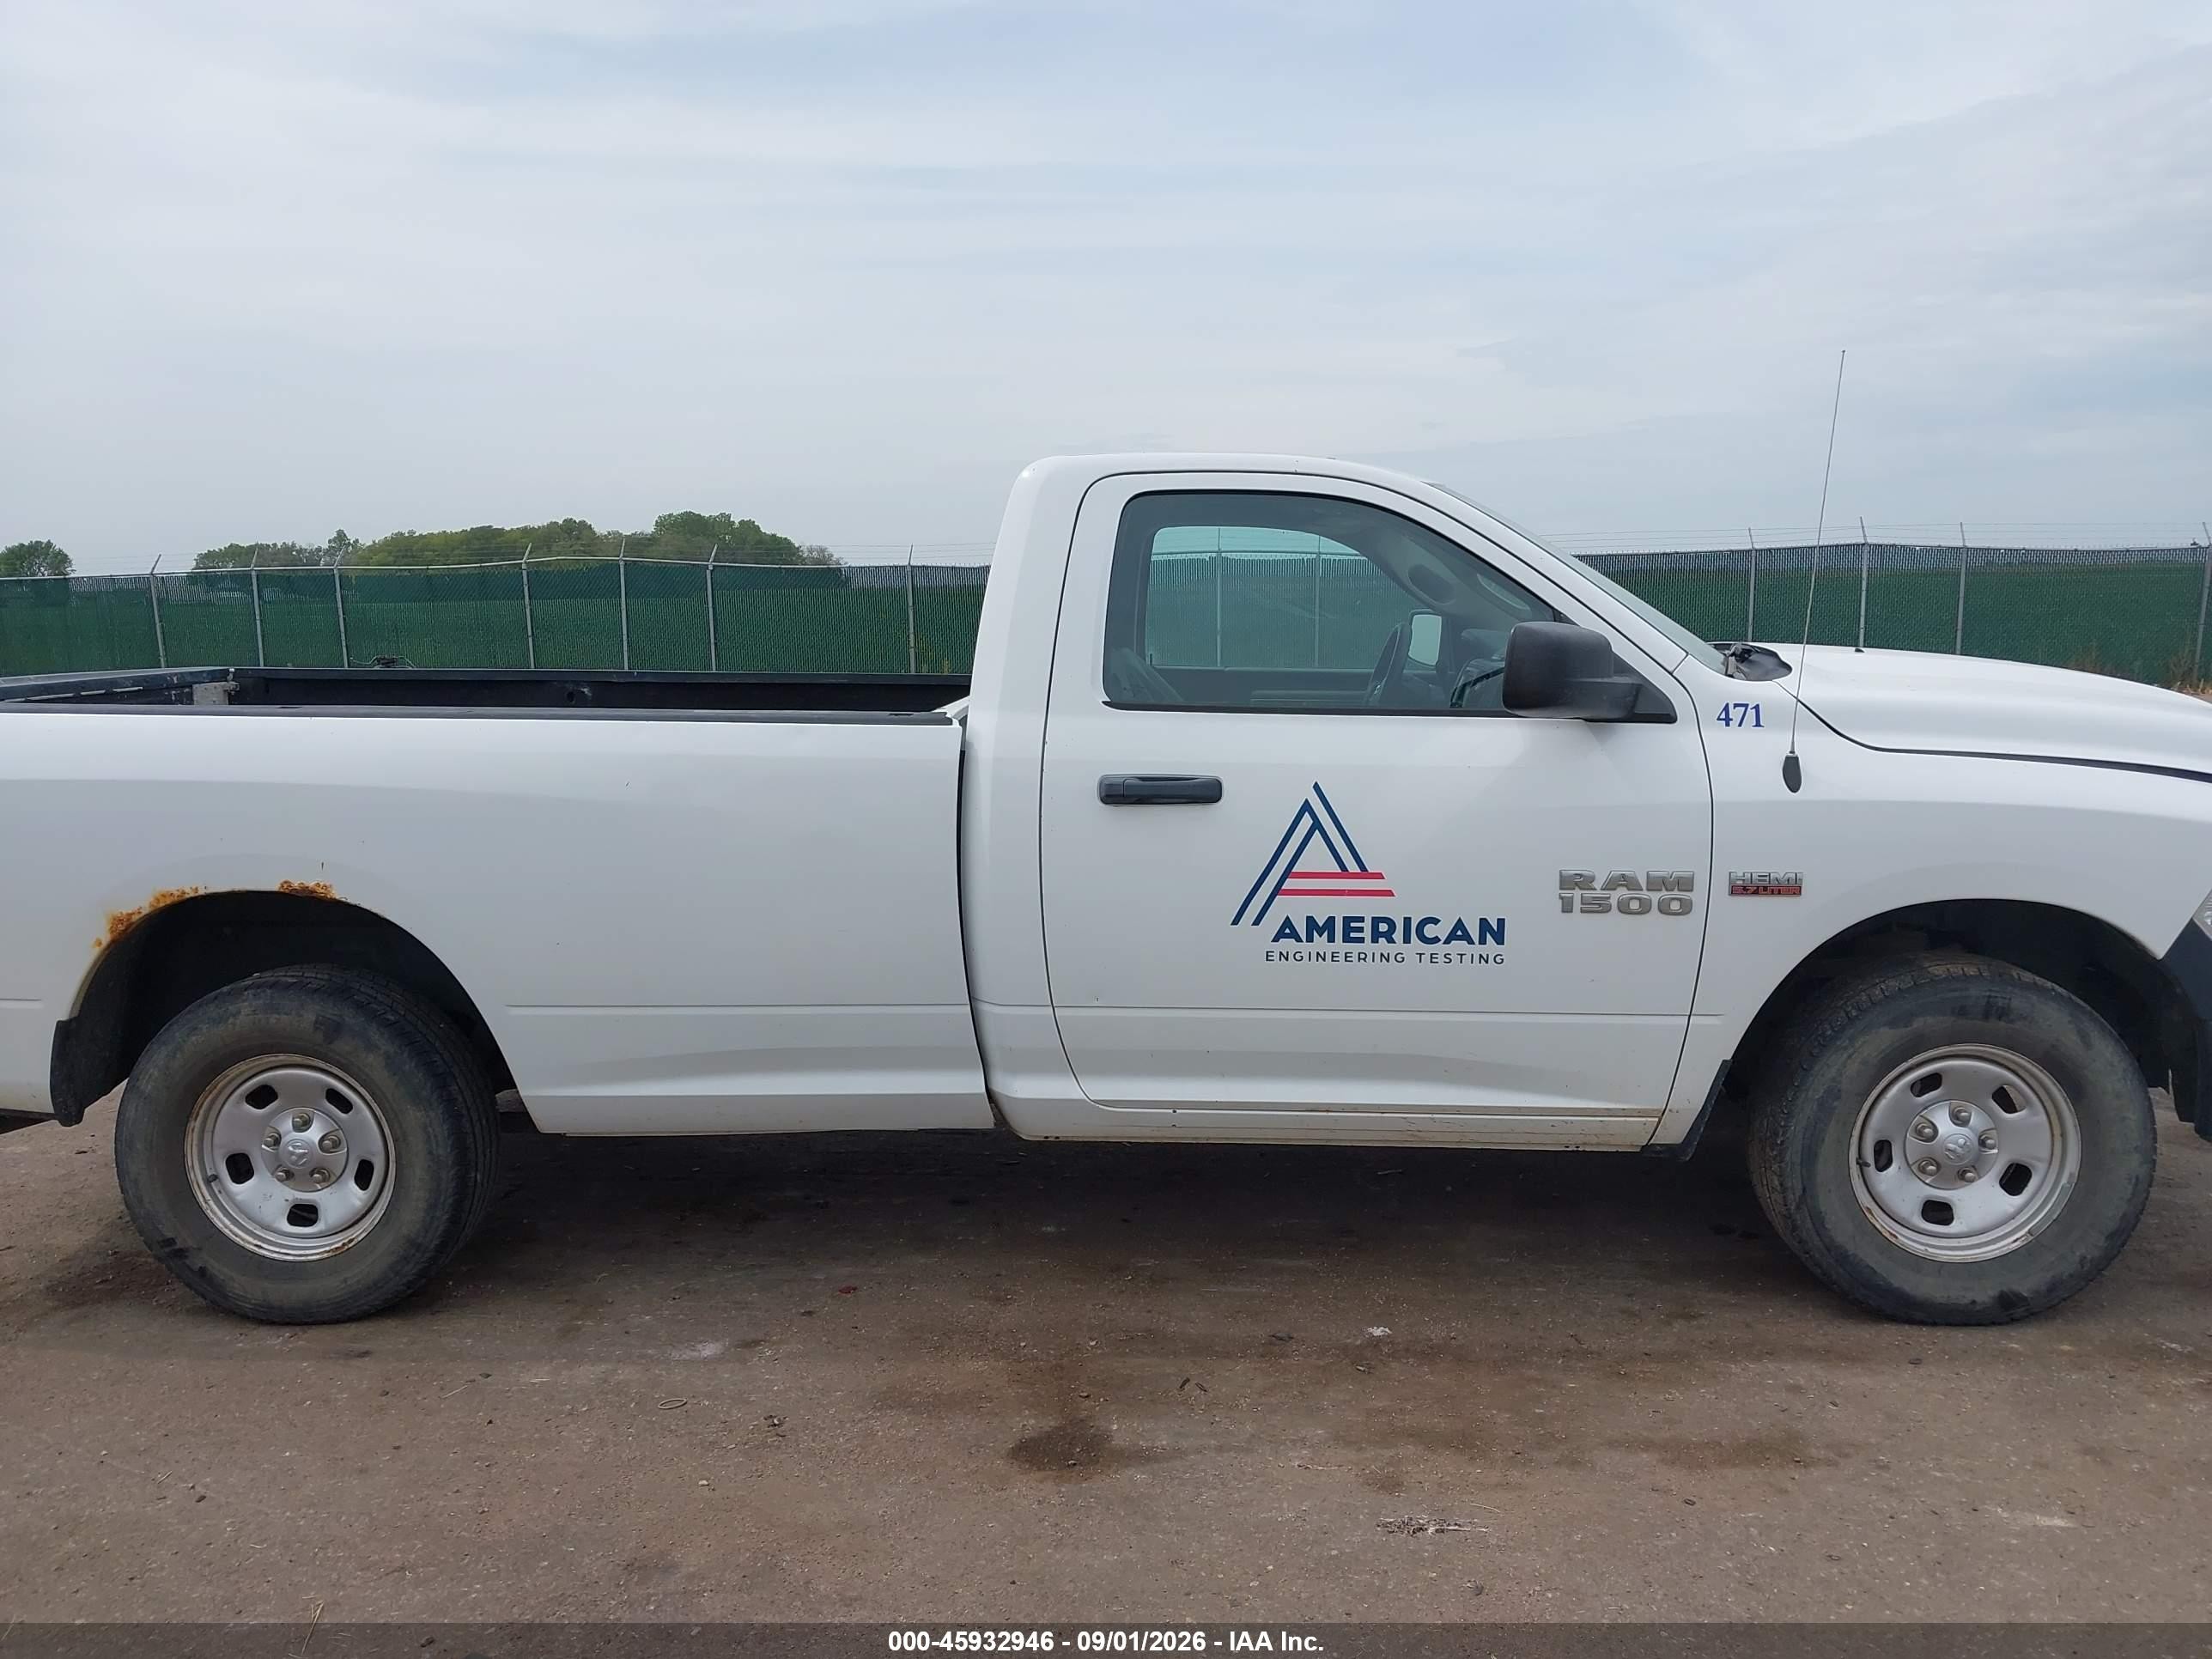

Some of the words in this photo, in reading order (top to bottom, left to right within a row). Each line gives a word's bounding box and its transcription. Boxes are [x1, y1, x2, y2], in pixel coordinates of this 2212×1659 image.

[1717, 702, 1765, 728] 471
[1559, 869, 1695, 891] RAM
[1729, 871, 1803, 885] HEMI
[1759, 885, 1802, 896] LITER
[1559, 892, 1693, 915] 1500
[1271, 915, 1506, 945] AMERICAN
[1265, 951, 1407, 963] ENGINEERING
[1415, 952, 1505, 965] TESTING
